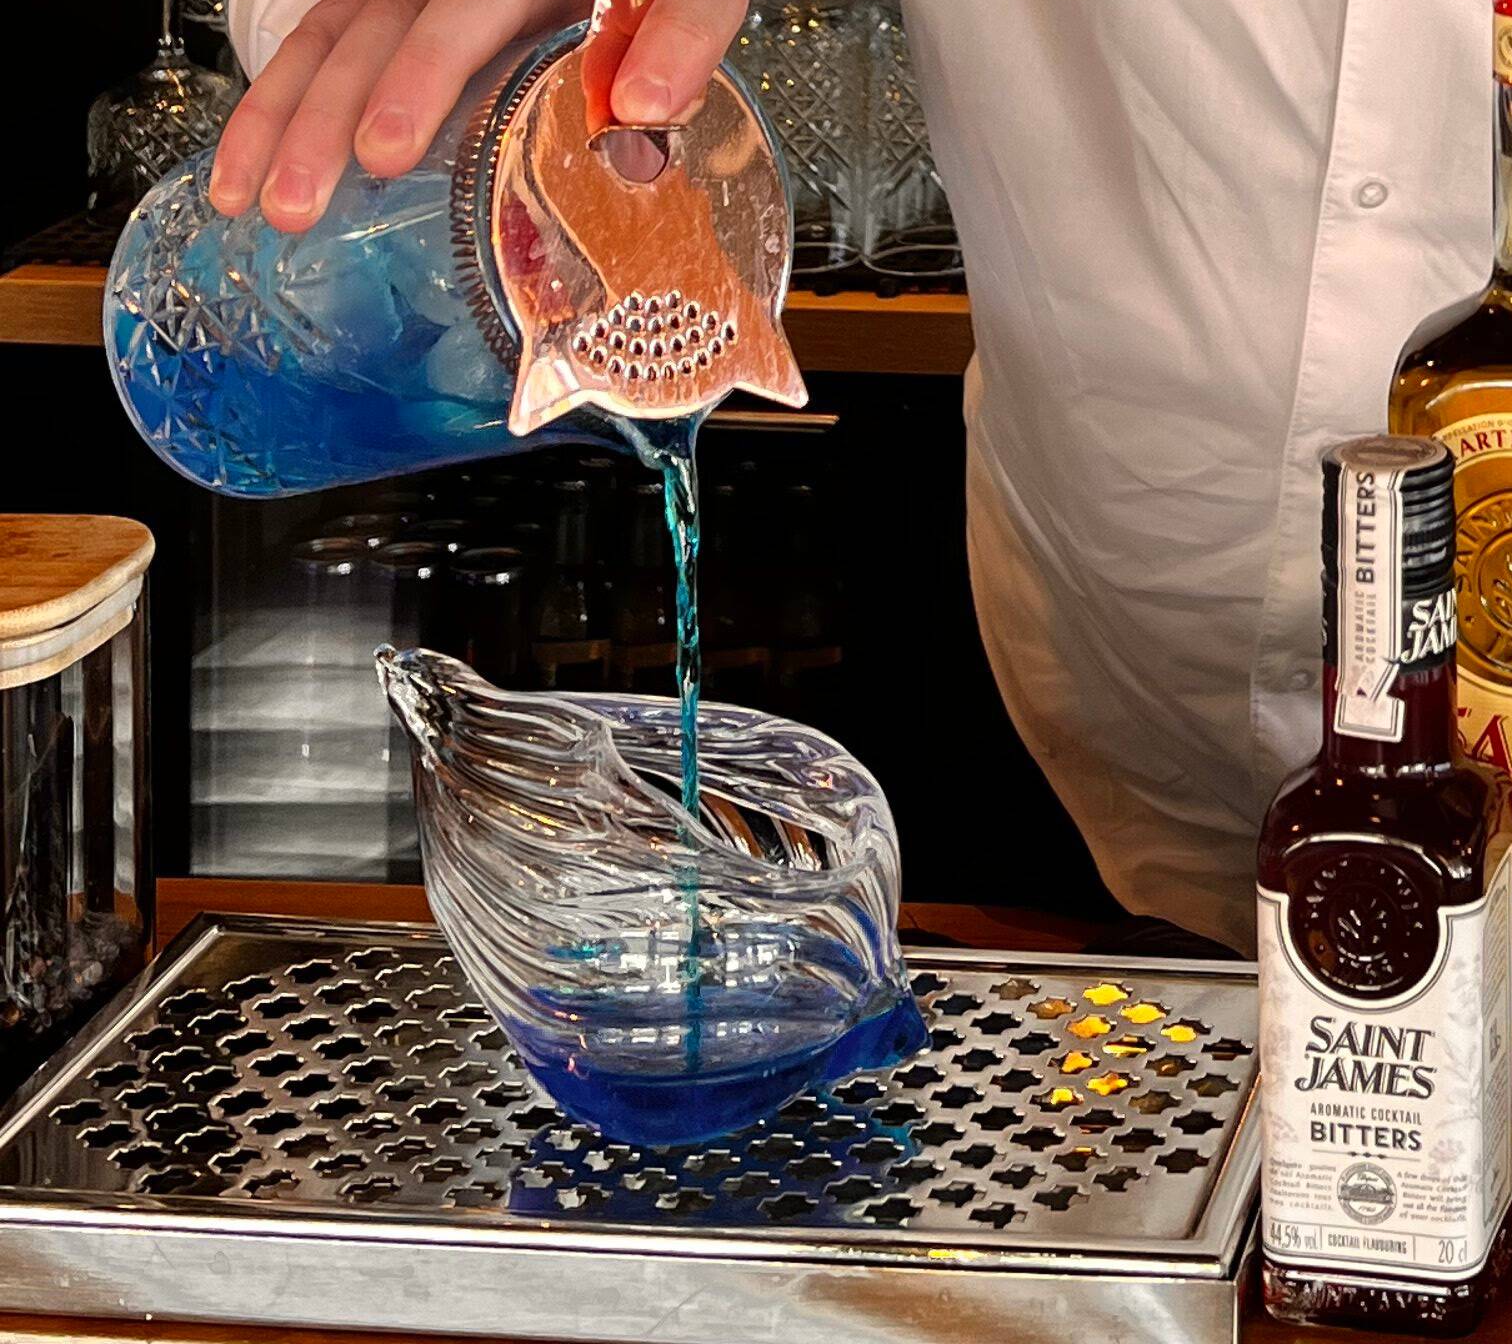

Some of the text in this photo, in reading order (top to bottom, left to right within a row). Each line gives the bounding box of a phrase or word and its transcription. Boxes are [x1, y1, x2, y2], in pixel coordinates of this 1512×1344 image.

[1355, 471, 1377, 585] BITTERS
[1305, 1014, 1437, 1062] SAINT
[1294, 1055, 1438, 1101] JAMES
[1310, 1101, 1422, 1126] AROMATIC COCKTAIL
[1309, 1120, 1424, 1152] BITTERS
[1403, 1170, 1418, 1180] few
[1420, 1173, 1441, 1184] drops
[1327, 1232, 1408, 1255] COCKTAIL FLAVOURING
[1437, 1238, 1468, 1265] 20 cl
